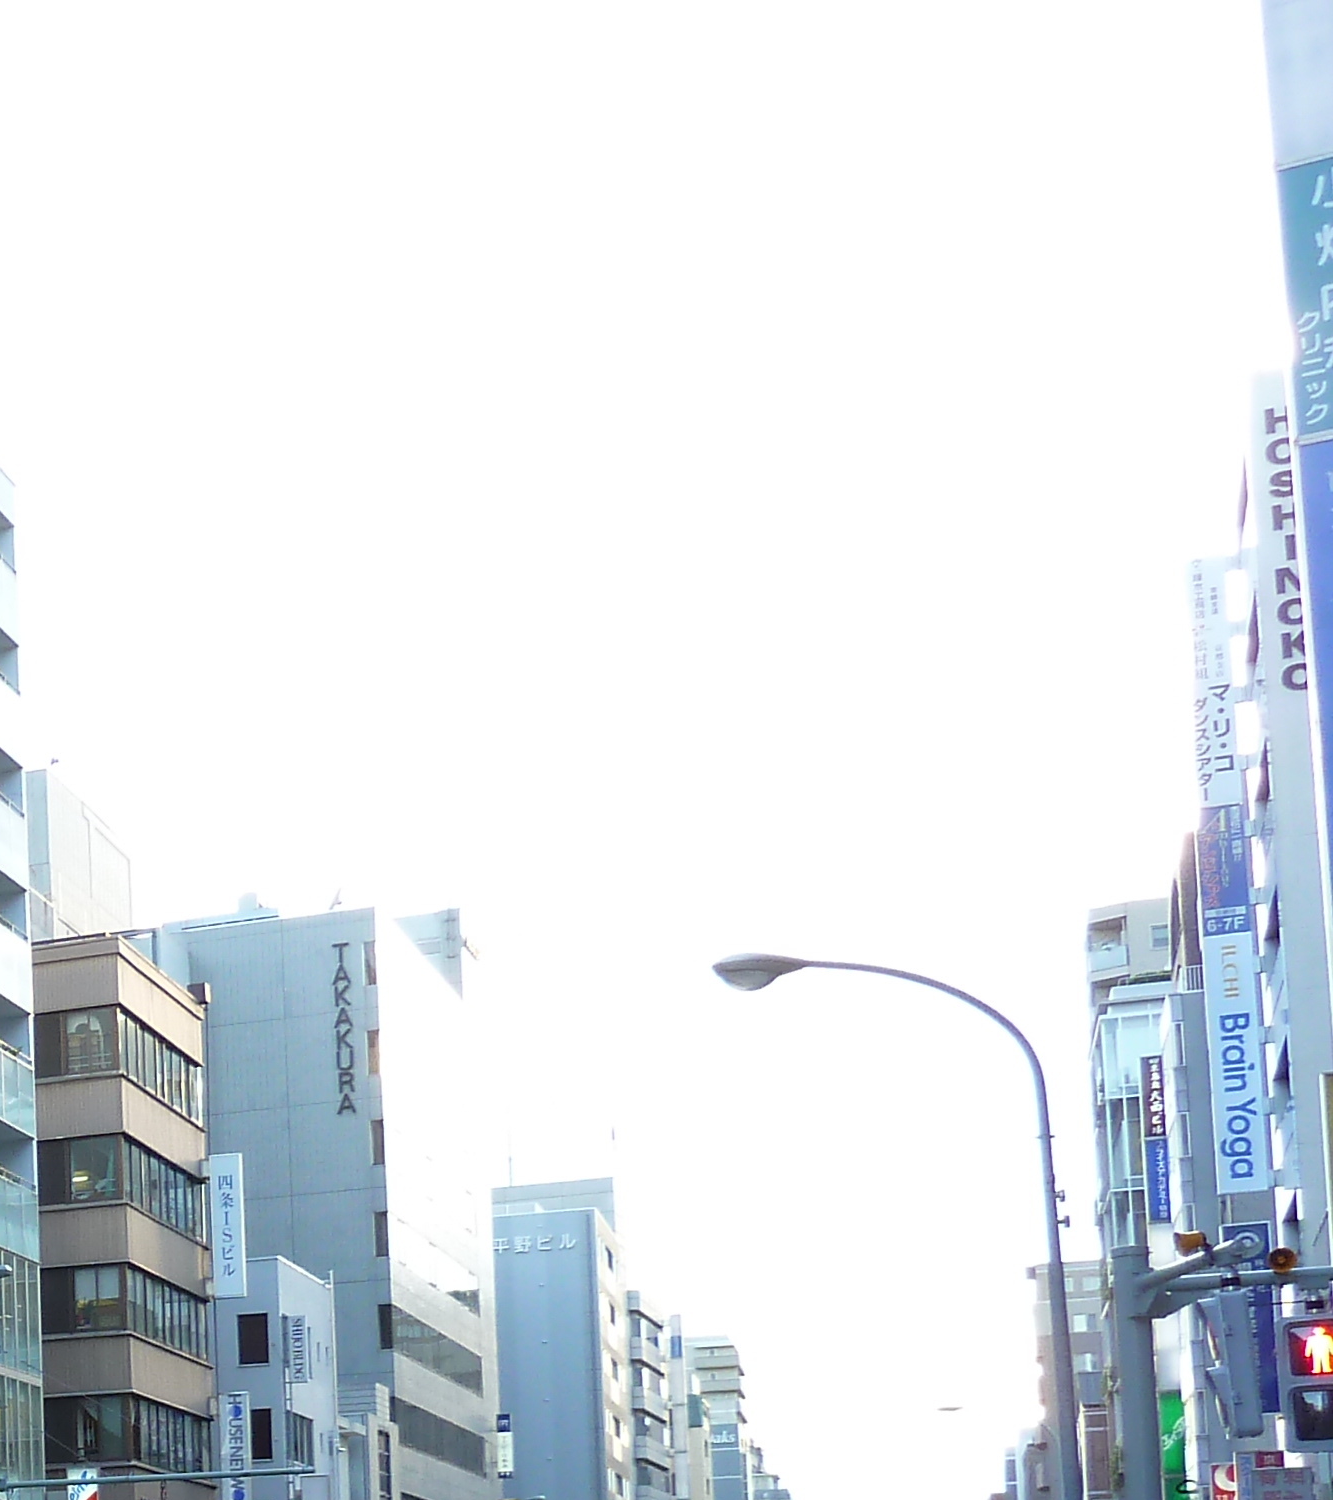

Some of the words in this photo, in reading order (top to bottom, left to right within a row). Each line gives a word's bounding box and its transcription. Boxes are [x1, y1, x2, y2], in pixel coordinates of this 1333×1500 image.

[1298, 311, 1328, 425] クリニック
[1207, 916, 1244, 932] 6-7F
[332, 942, 356, 1115] TAKAKURA
[1221, 1013, 1250, 1091] Brain
[1223, 1098, 1255, 1180] Yoga
[218, 1174, 235, 1276] 四条ISビル
[494, 1234, 576, 1254] 平野ビル
